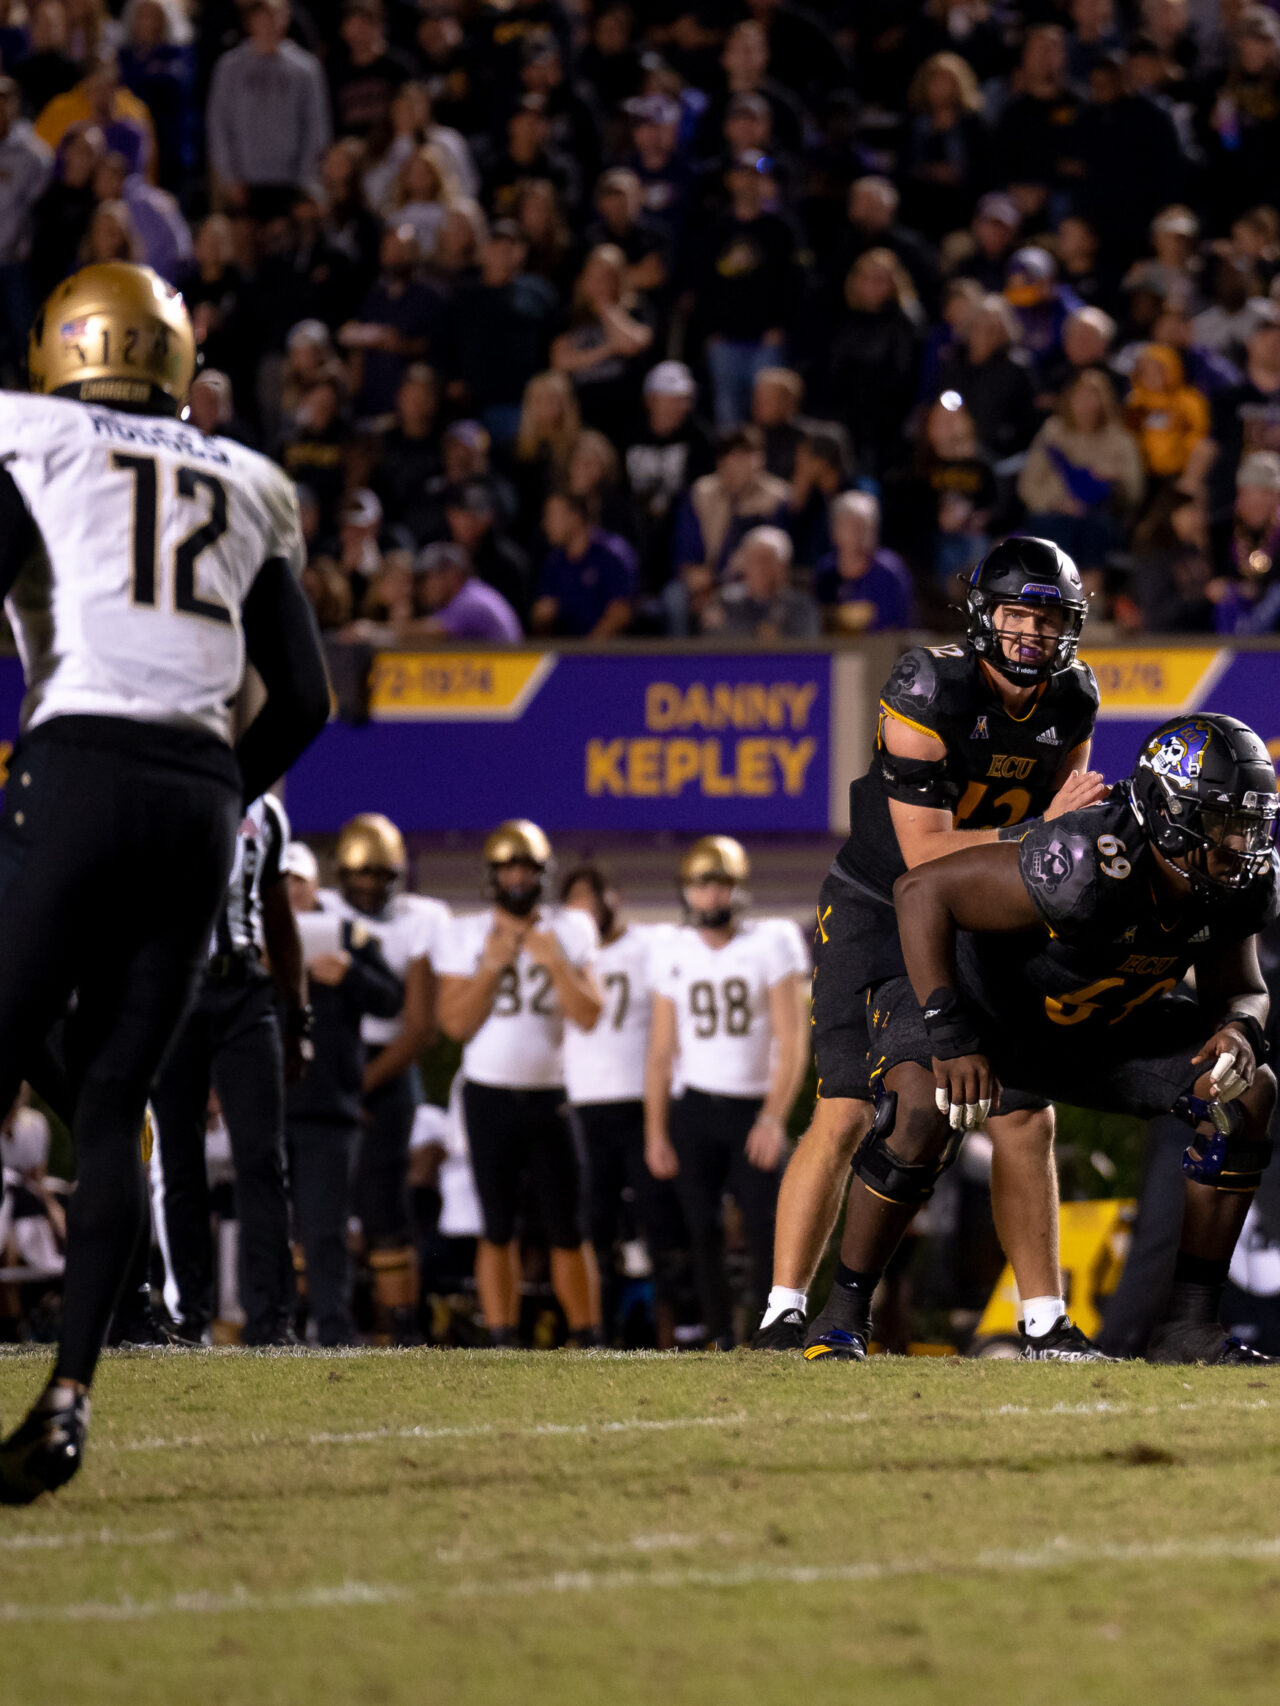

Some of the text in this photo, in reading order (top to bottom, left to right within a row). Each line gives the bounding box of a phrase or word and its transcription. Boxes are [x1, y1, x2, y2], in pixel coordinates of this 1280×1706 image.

[109, 449, 233, 624] 12
[646, 682, 817, 732] DANNY
[1179, 727, 1201, 744] ECU
[586, 736, 816, 797] KEPLEY
[986, 754, 1037, 780] ECU
[1097, 833, 1132, 879] 69
[1115, 954, 1179, 975] ECU
[689, 977, 752, 1039] 98
